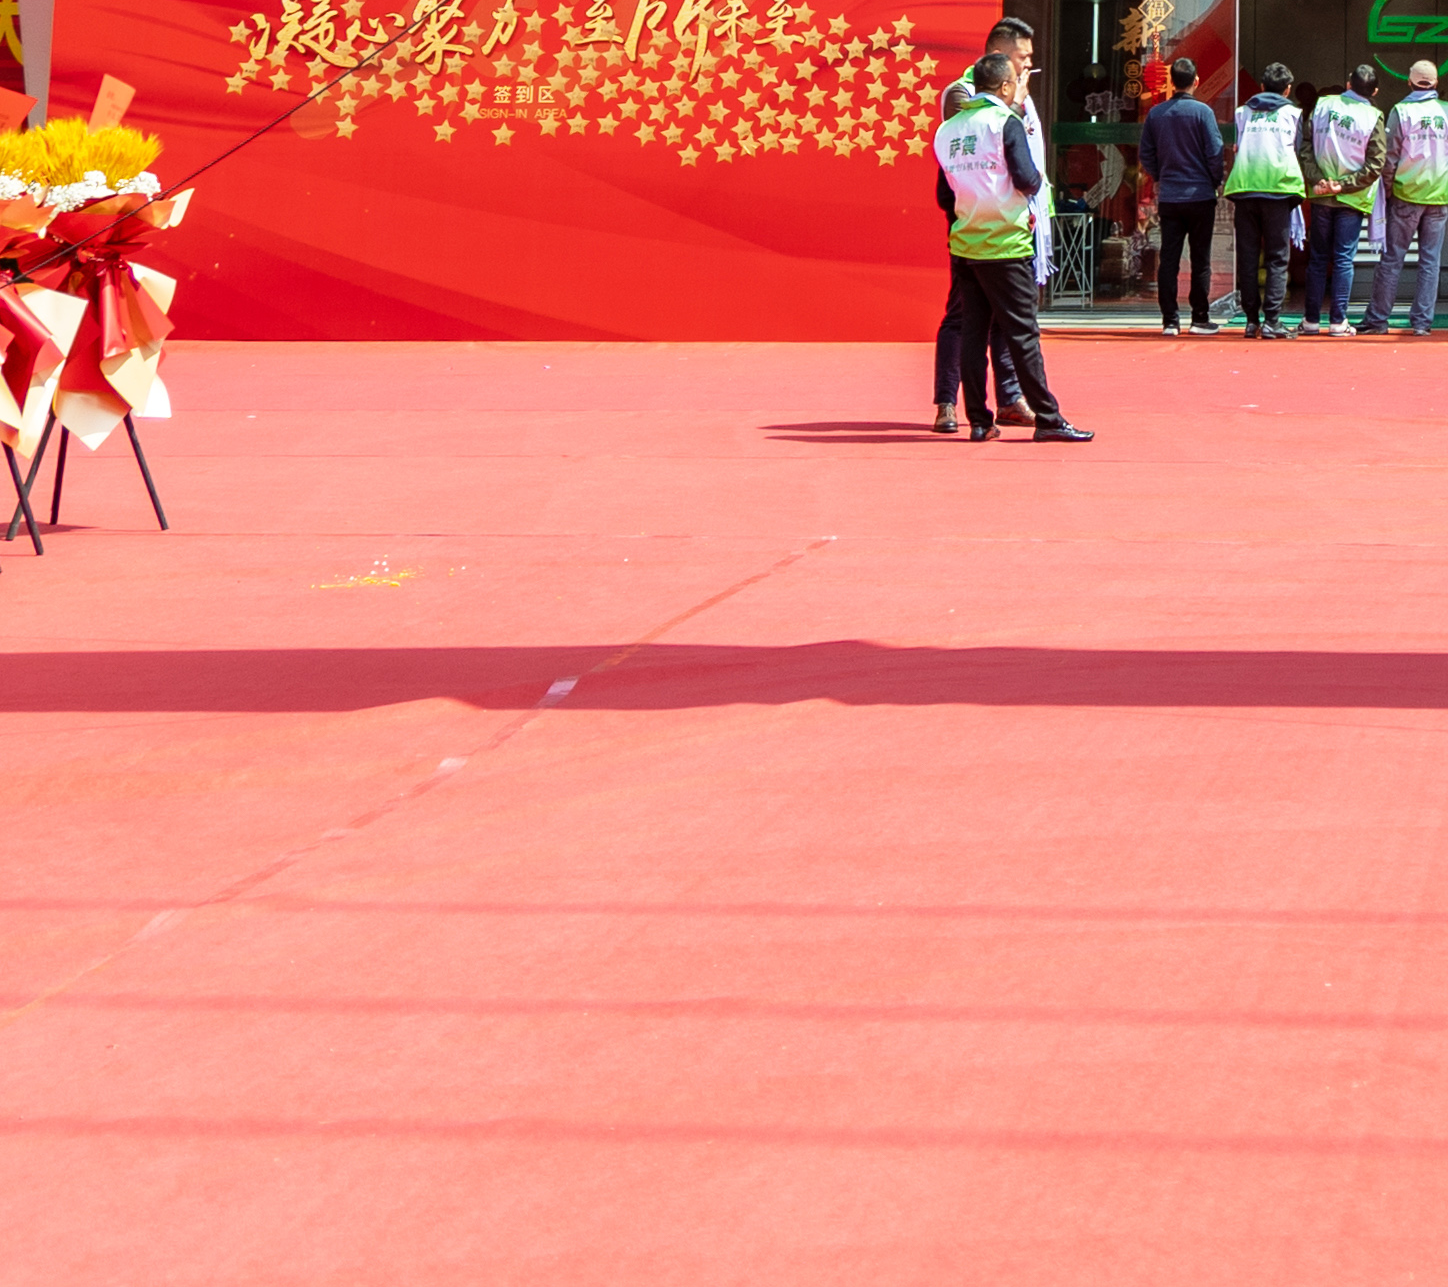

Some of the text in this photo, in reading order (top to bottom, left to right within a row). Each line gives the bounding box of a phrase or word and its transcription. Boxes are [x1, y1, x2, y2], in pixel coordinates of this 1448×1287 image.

[493, 85, 556, 105] 签到区
[534, 108, 568, 119] AREA
[949, 135, 977, 159] 萨震
